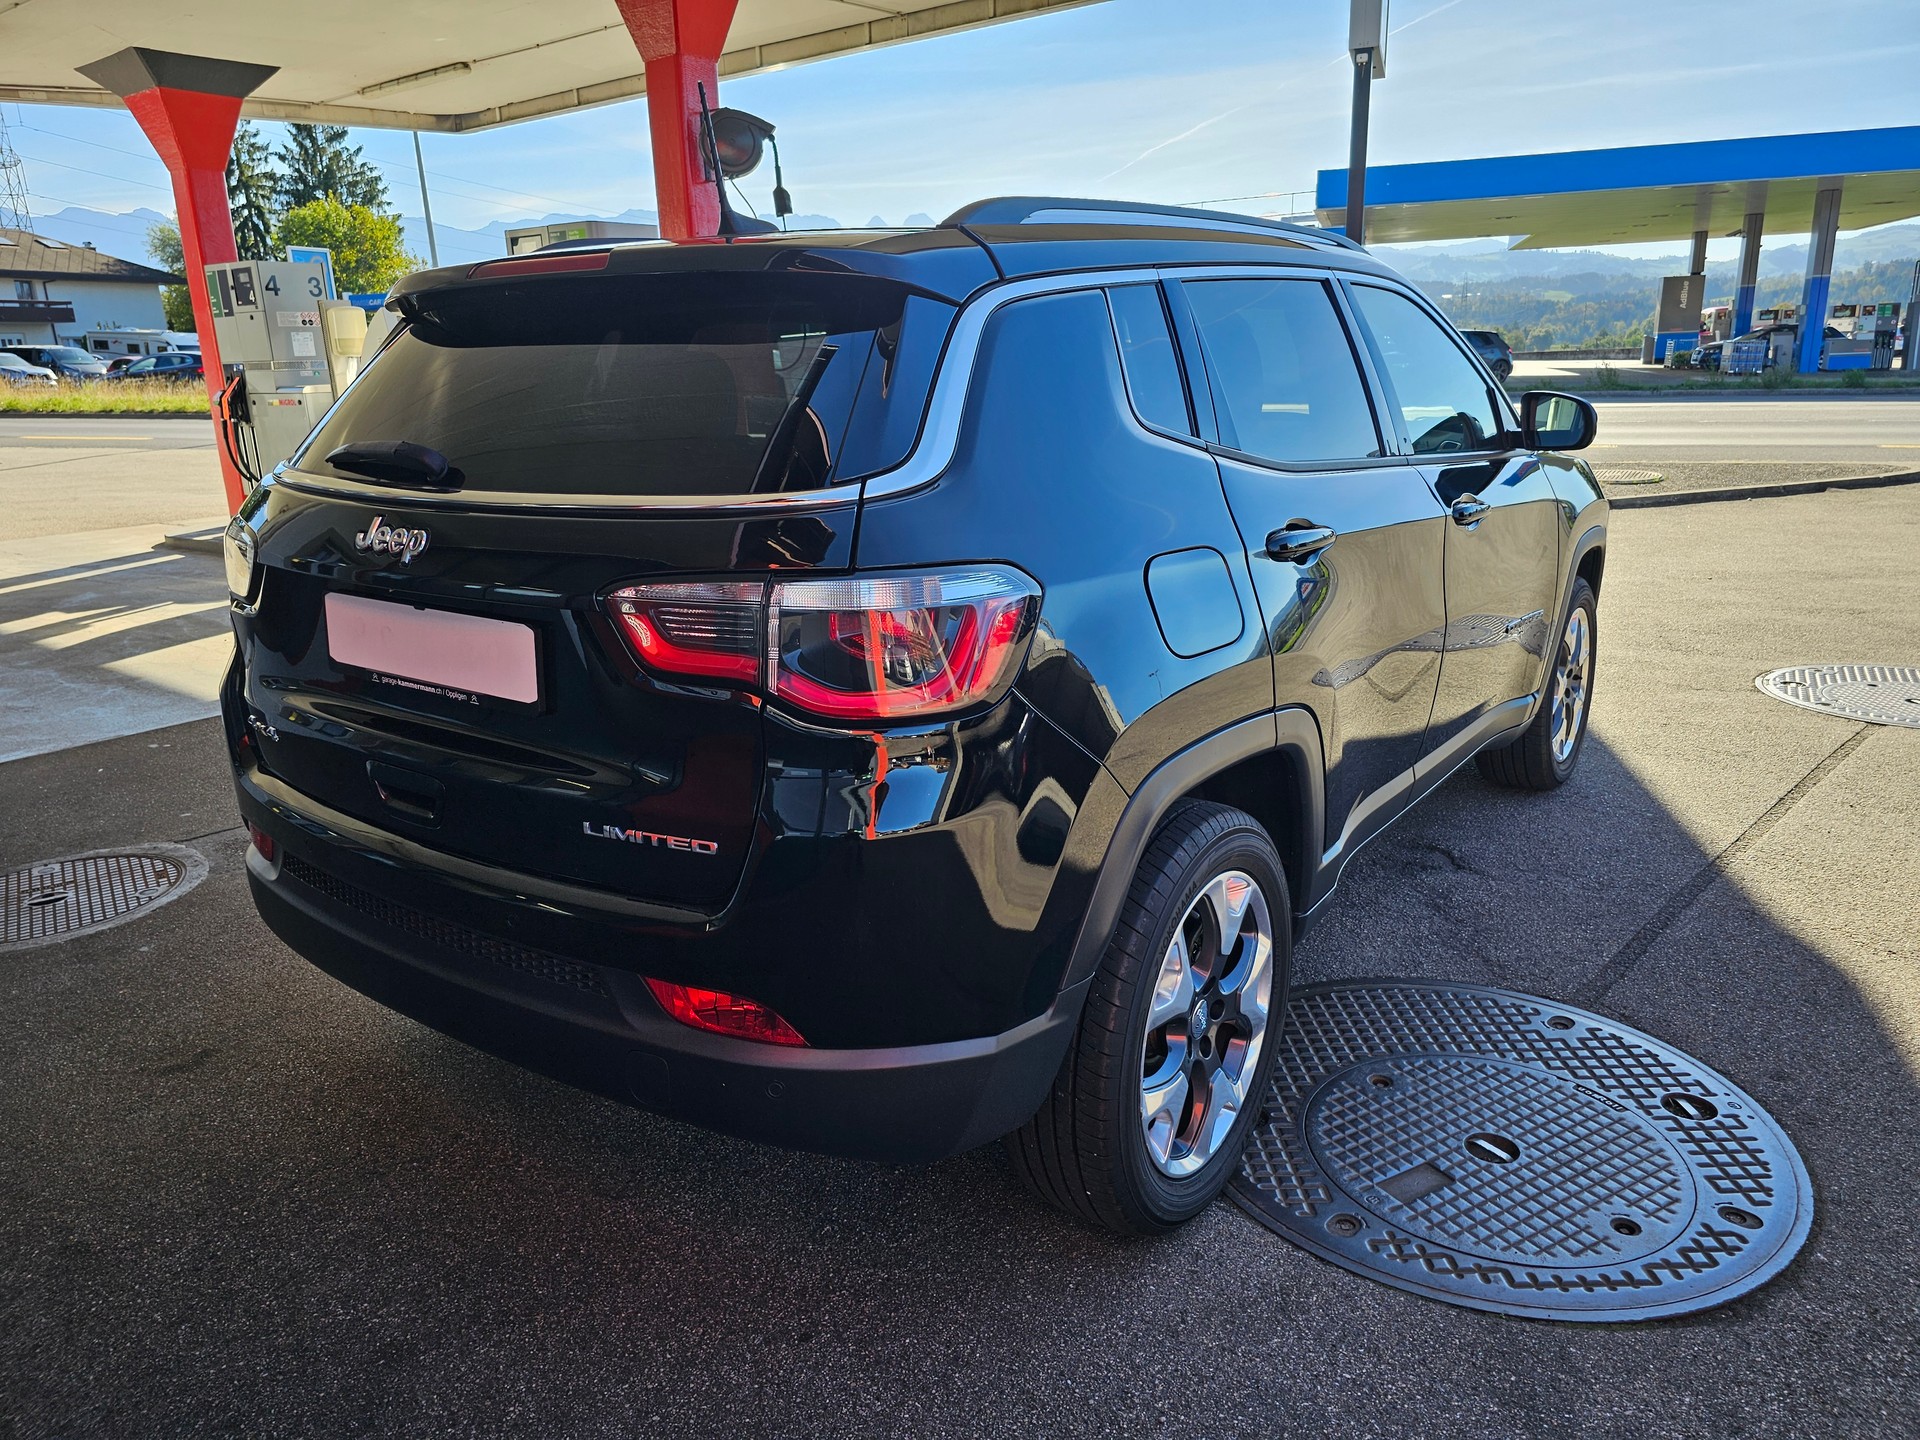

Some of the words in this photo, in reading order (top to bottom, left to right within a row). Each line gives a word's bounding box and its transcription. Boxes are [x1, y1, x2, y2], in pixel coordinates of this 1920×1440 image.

[249, 289, 256, 303] 4
[265, 275, 280, 297] 4
[308, 276, 323, 298] 3
[1679, 280, 1690, 309] AdBlue
[354, 514, 429, 568] Jeep
[445, 689, 468, 702] Oppligen
[582, 821, 719, 856] LIMITED
[1158, 880, 1198, 956] YOKOHAMA
